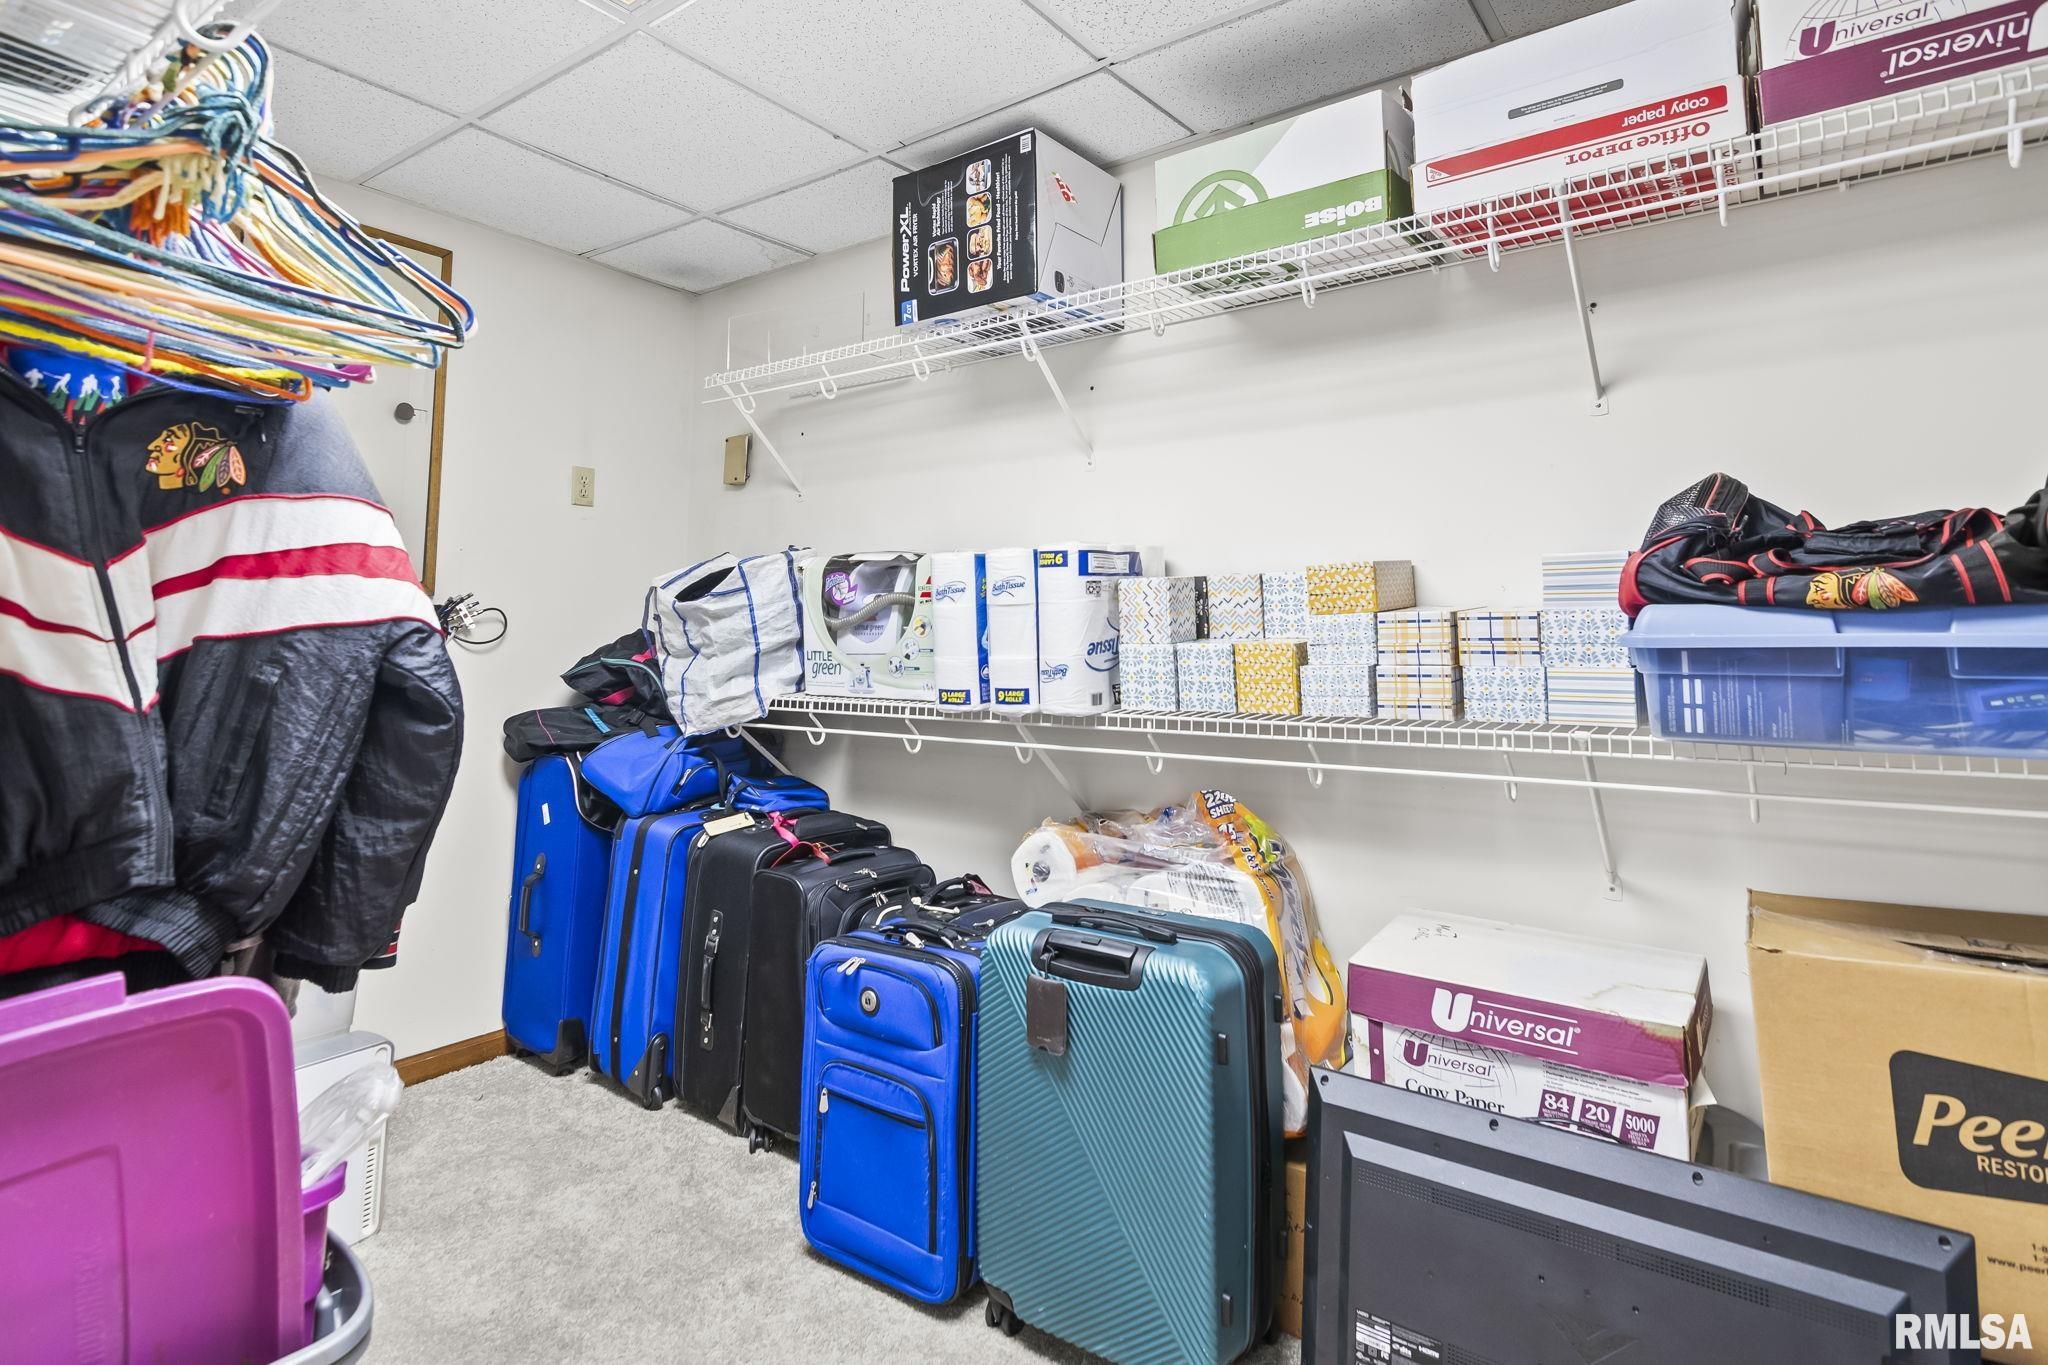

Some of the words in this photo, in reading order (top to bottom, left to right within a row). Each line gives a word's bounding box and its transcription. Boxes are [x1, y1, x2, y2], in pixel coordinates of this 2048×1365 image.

[1799, 5, 1930, 56] Universal
[1622, 106, 1666, 128] paper
[1669, 96, 1710, 116] copy
[1637, 121, 1711, 147] Office
[1565, 140, 1633, 166] DEPOT
[899, 203, 912, 292] PowerXL
[806, 650, 833, 661] LITTLE
[812, 662, 842, 678] green
[941, 692, 948, 702] 9
[997, 691, 1005, 702] 9
[1430, 987, 1575, 1047] Universal
[1402, 1039, 1493, 1077] Universal
[1544, 1092, 1570, 1113] 84
[1584, 1103, 1611, 1123] 20
[1625, 1114, 1656, 1136] 5000
[1912, 1093, 2048, 1160] Pee
